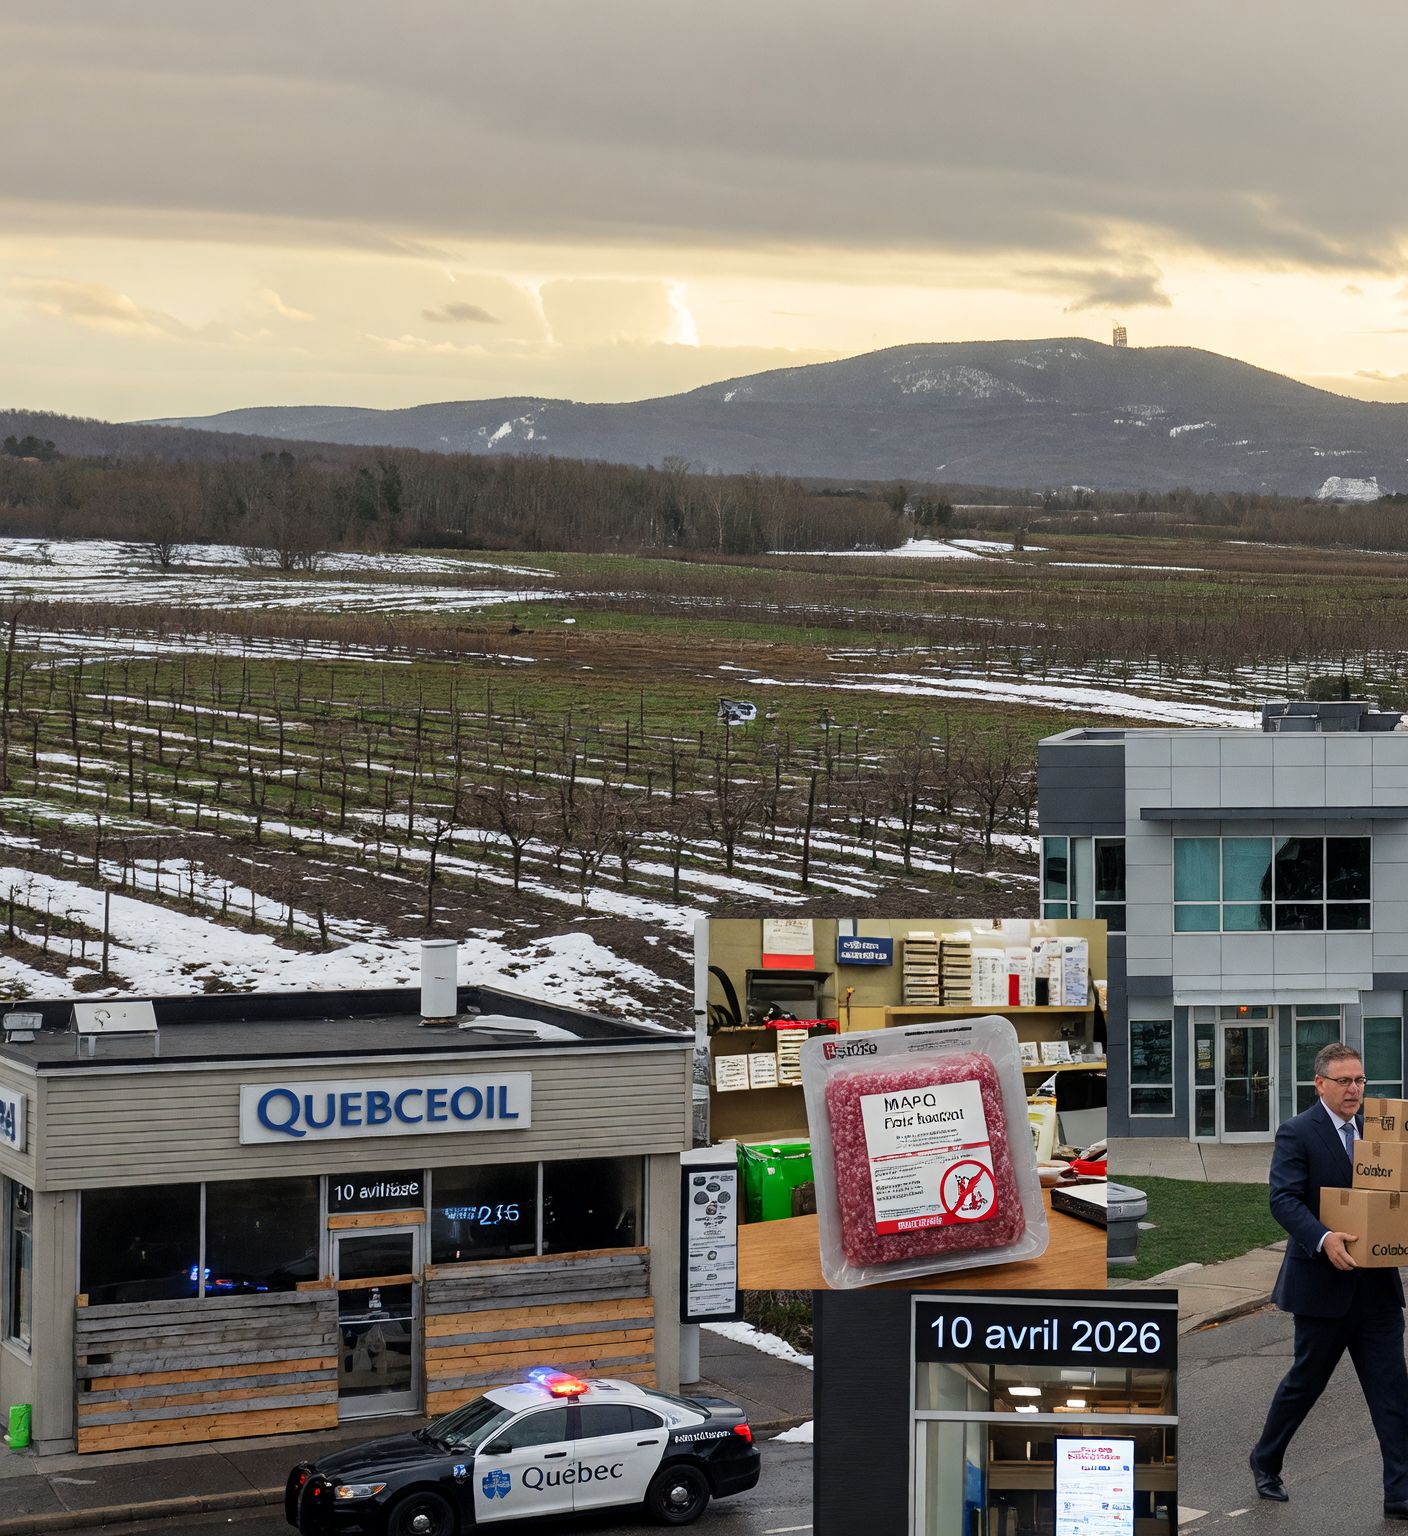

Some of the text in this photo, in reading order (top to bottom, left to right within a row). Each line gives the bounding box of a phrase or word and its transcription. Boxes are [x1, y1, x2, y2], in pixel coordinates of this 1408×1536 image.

[257, 1086, 519, 1137] QUEBCEOIL
[334, 1184, 354, 1201] 10
[931, 1315, 1161, 1354] 10 avril 2026
[522, 1461, 623, 1491] Québec
